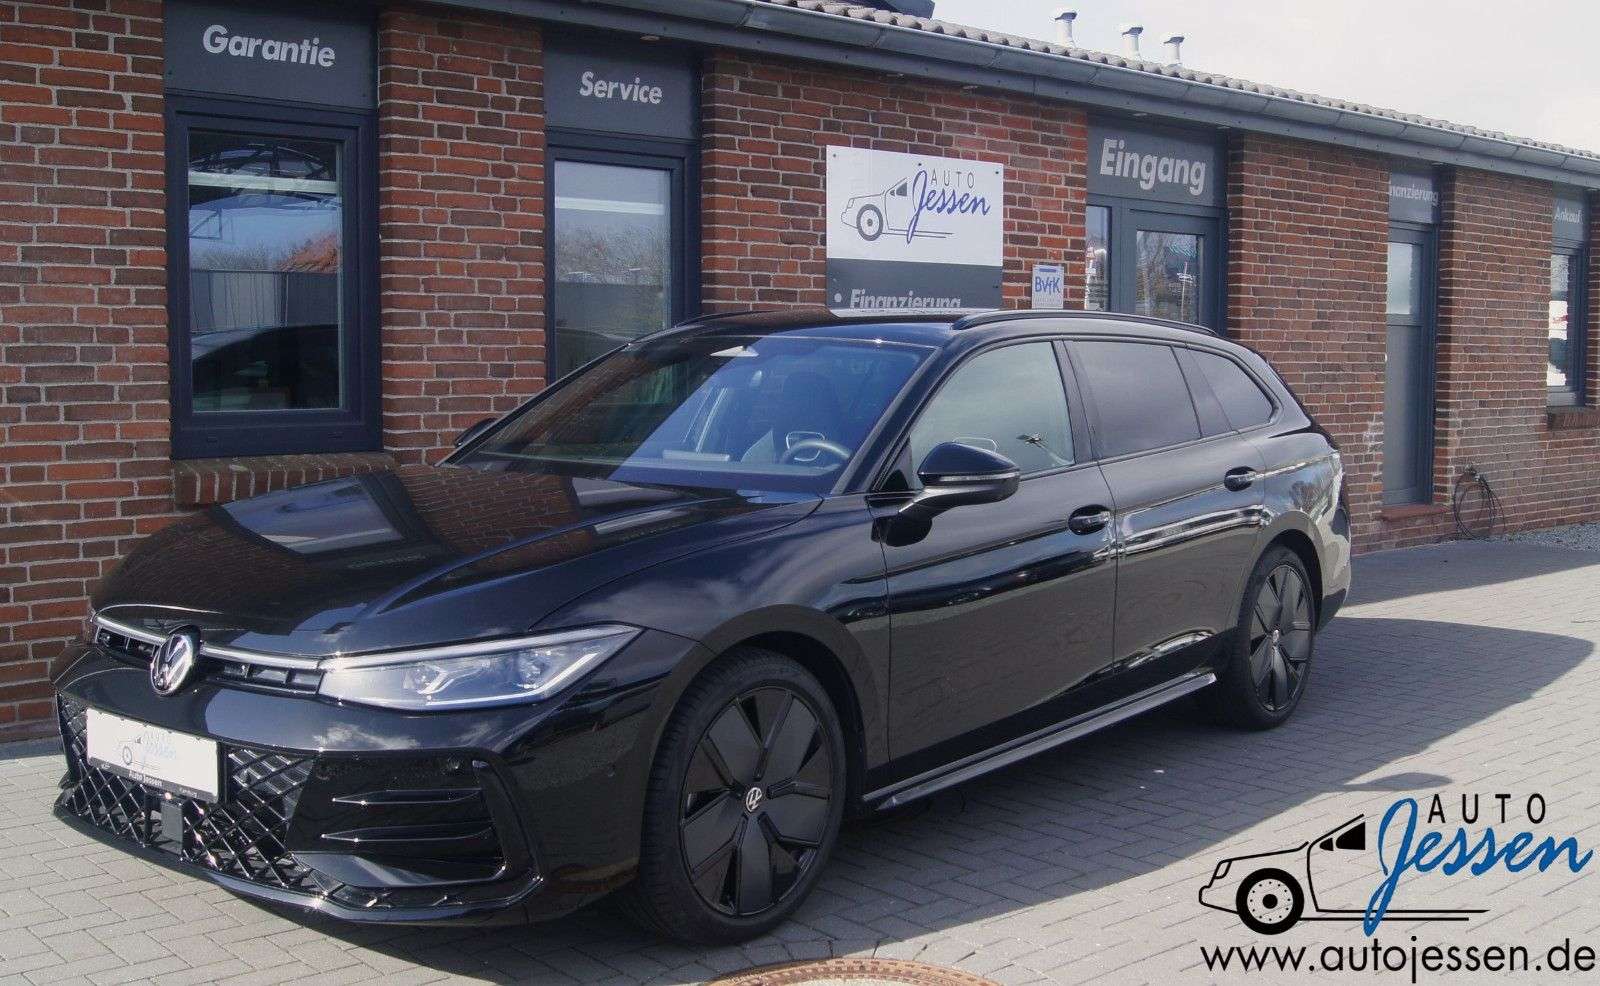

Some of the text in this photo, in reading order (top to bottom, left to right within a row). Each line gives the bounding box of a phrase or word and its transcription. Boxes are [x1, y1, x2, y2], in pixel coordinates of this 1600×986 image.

[202, 24, 336, 68] Garantie
[579, 71, 663, 105] Service
[930, 168, 975, 189] AUTO
[1099, 138, 1207, 196] Eingang
[906, 169, 991, 245] Jessen
[1389, 184, 1439, 207] nanzierung
